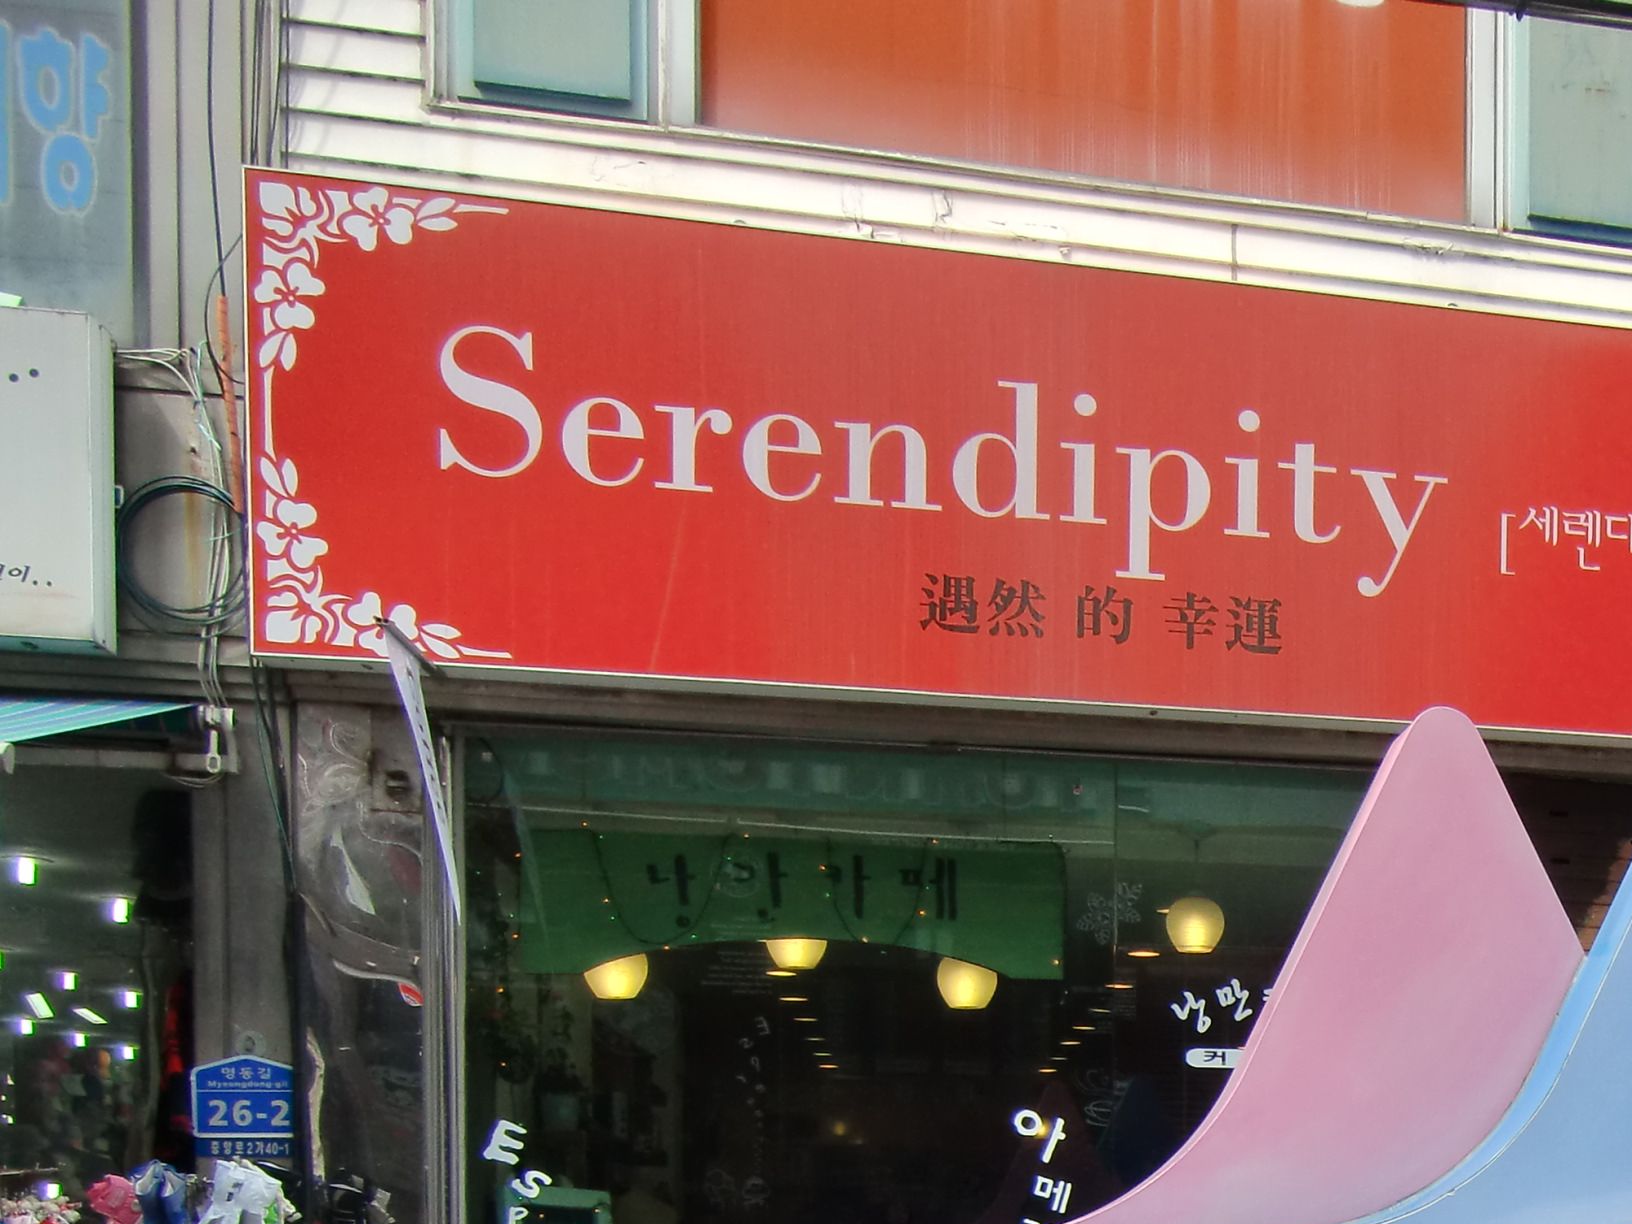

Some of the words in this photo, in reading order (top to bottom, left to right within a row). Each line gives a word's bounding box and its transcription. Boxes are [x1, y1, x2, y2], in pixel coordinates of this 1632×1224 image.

[438, 325, 1447, 598] Serendipity
[920, 573, 1047, 639] 遇然
[1076, 585, 1134, 645] 的
[1163, 591, 1282, 655] 幸運
[1170, 978, 1274, 1034] 낭만
[221, 1067, 272, 1080] 명동길
[208, 1099, 291, 1127] 26-2
